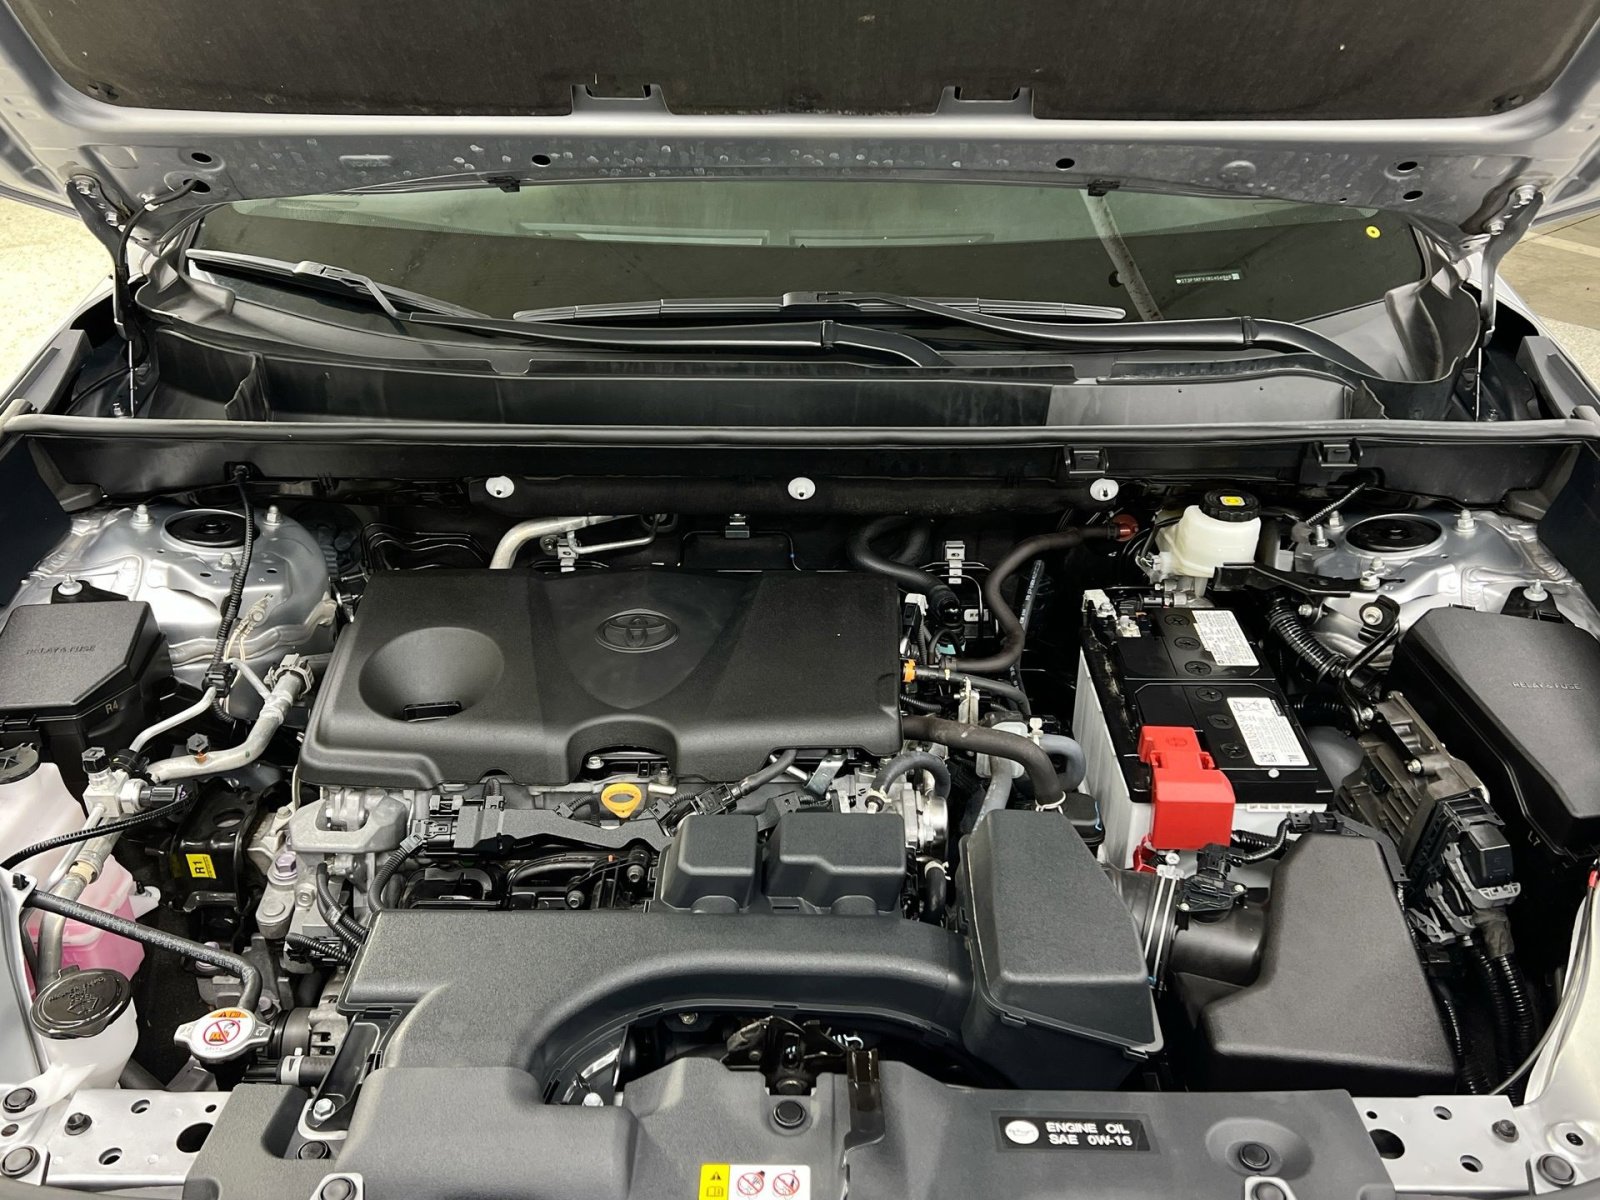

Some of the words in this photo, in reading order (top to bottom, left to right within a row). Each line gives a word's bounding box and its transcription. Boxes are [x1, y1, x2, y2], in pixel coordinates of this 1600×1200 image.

[105, 700, 119, 714] R4
[193, 861, 205, 874] R1
[1045, 1121, 1098, 1134] ENGINE
[1105, 1123, 1130, 1135] OIL
[1048, 1133, 1079, 1146] SAE
[1087, 1134, 1133, 1147] 0W-16
